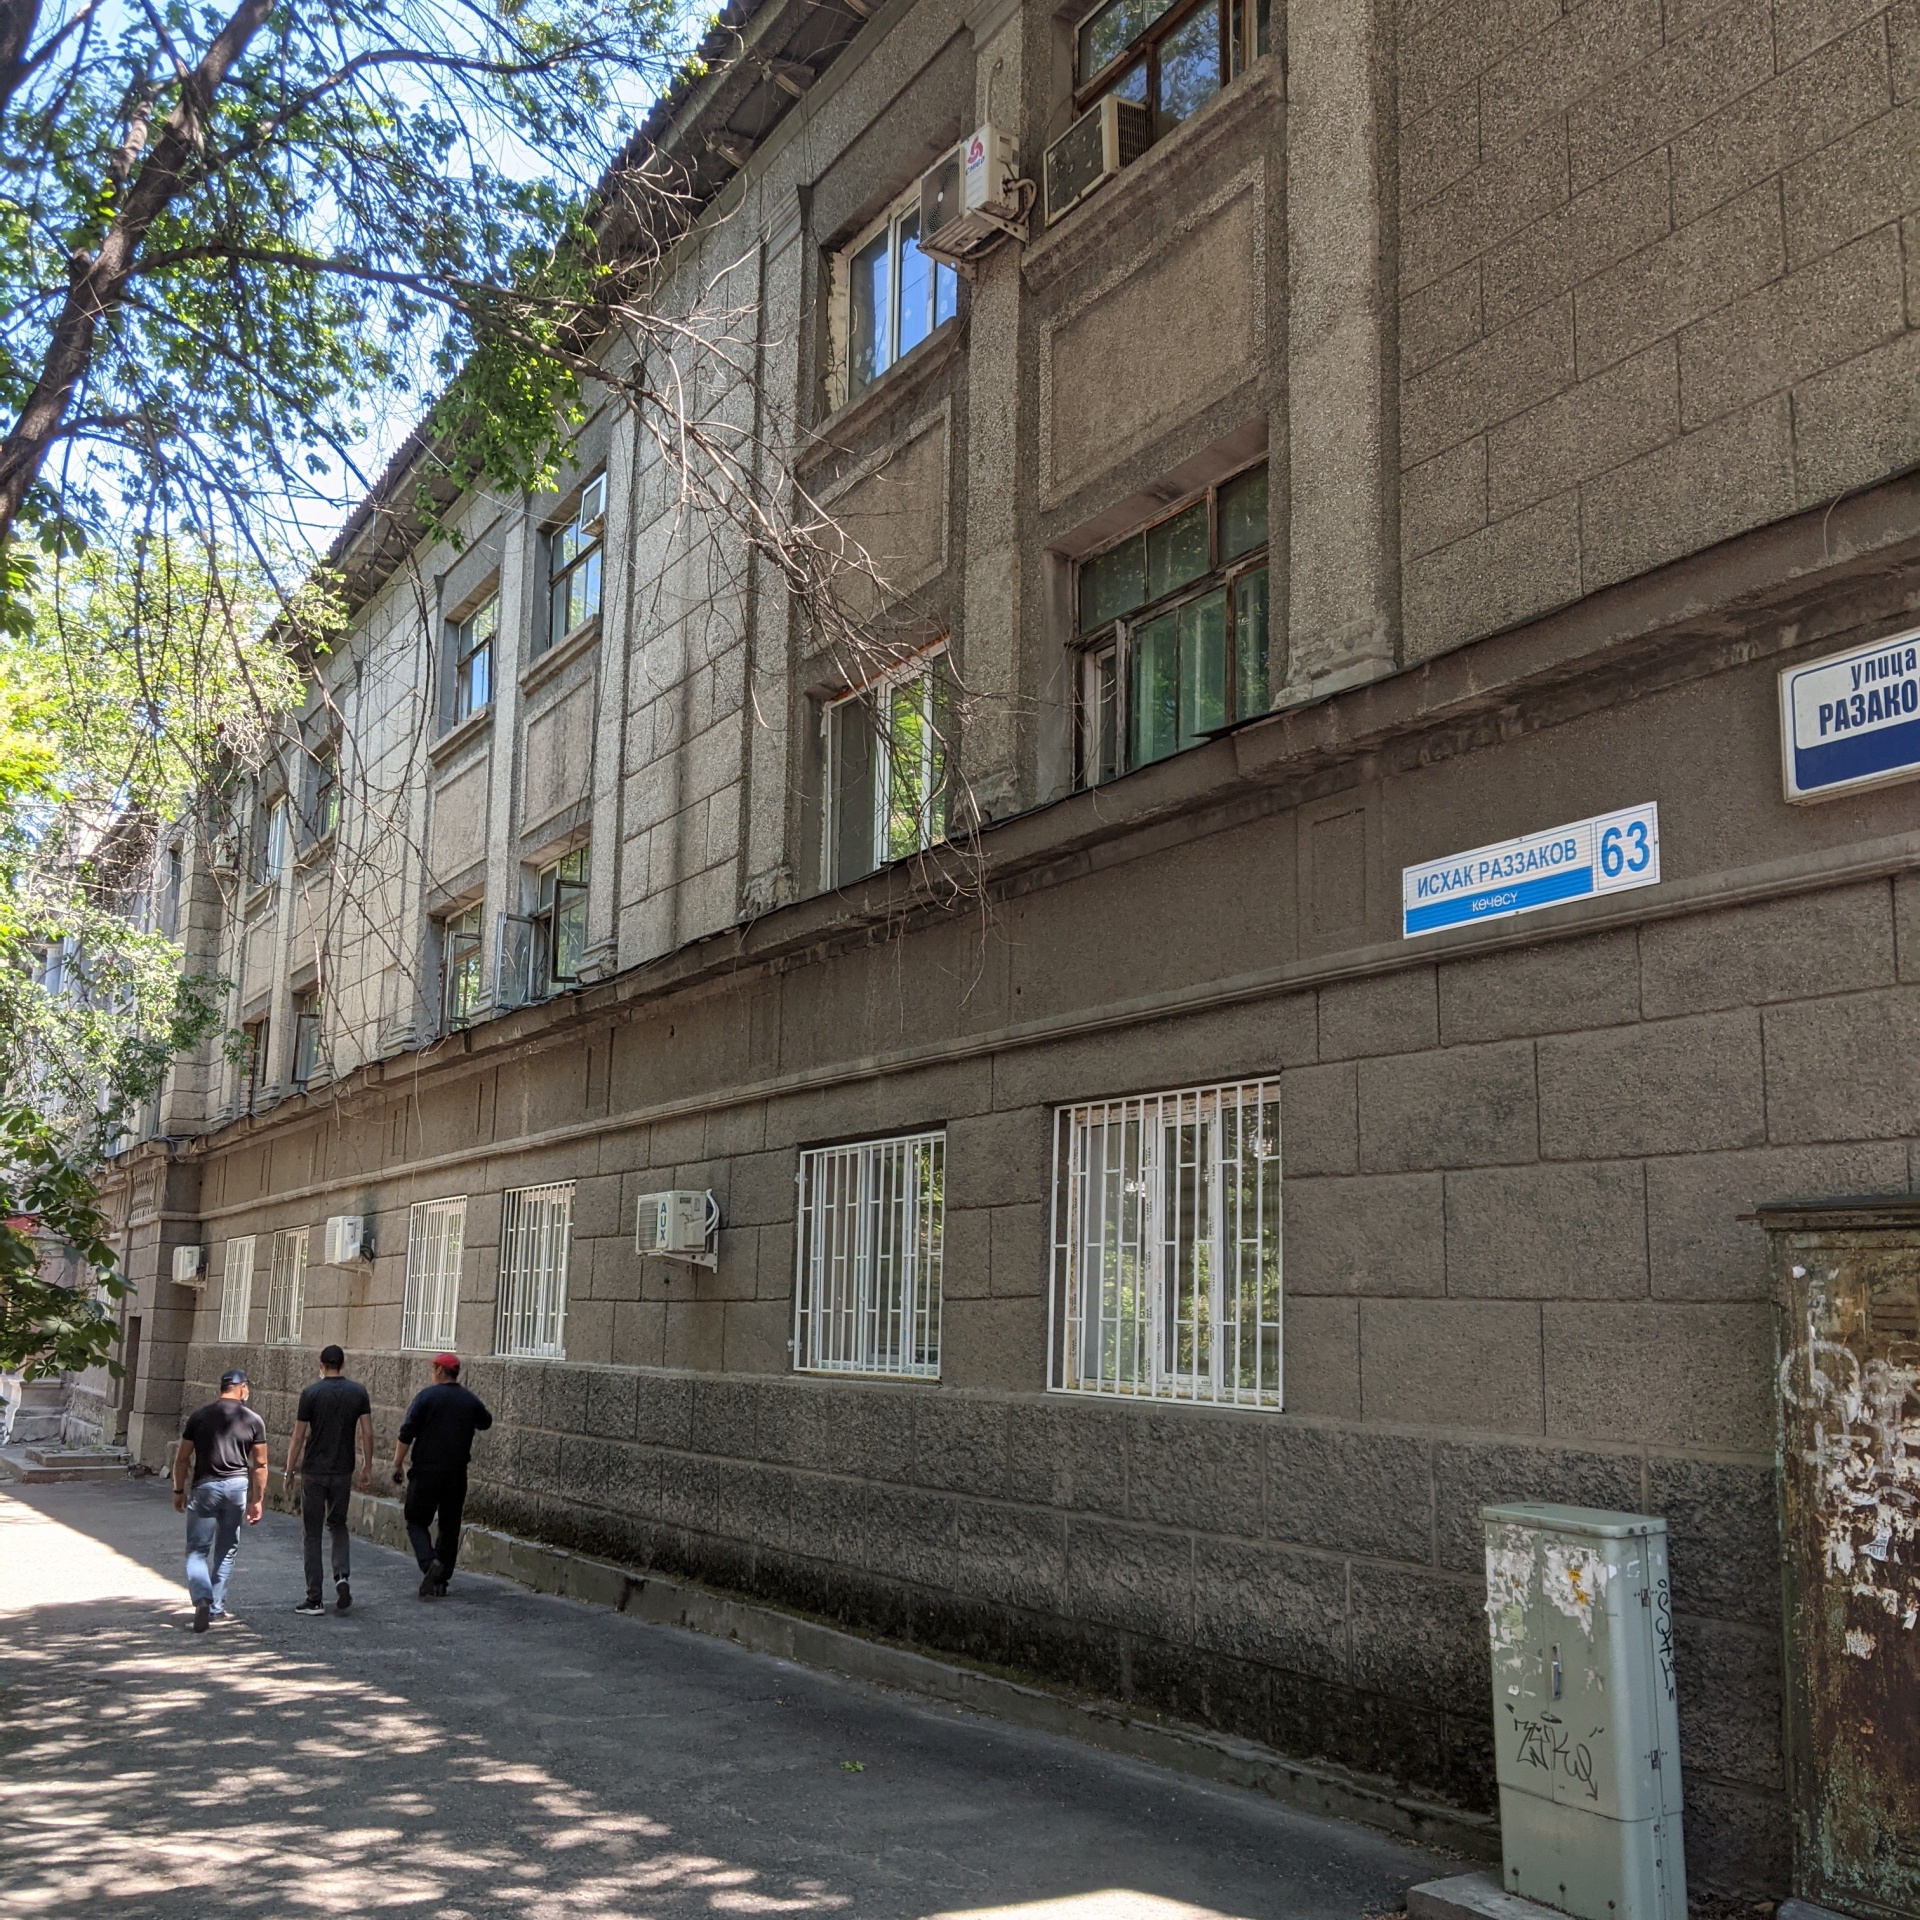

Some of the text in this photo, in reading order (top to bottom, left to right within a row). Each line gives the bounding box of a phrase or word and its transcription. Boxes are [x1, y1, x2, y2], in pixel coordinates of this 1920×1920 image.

[1850, 648, 1917, 692] улица
[1819, 678, 1920, 737] РАЗАКО
[1417, 838, 1577, 898] ИСХАК РАЗЗАКОВ
[1601, 820, 1650, 878] 63
